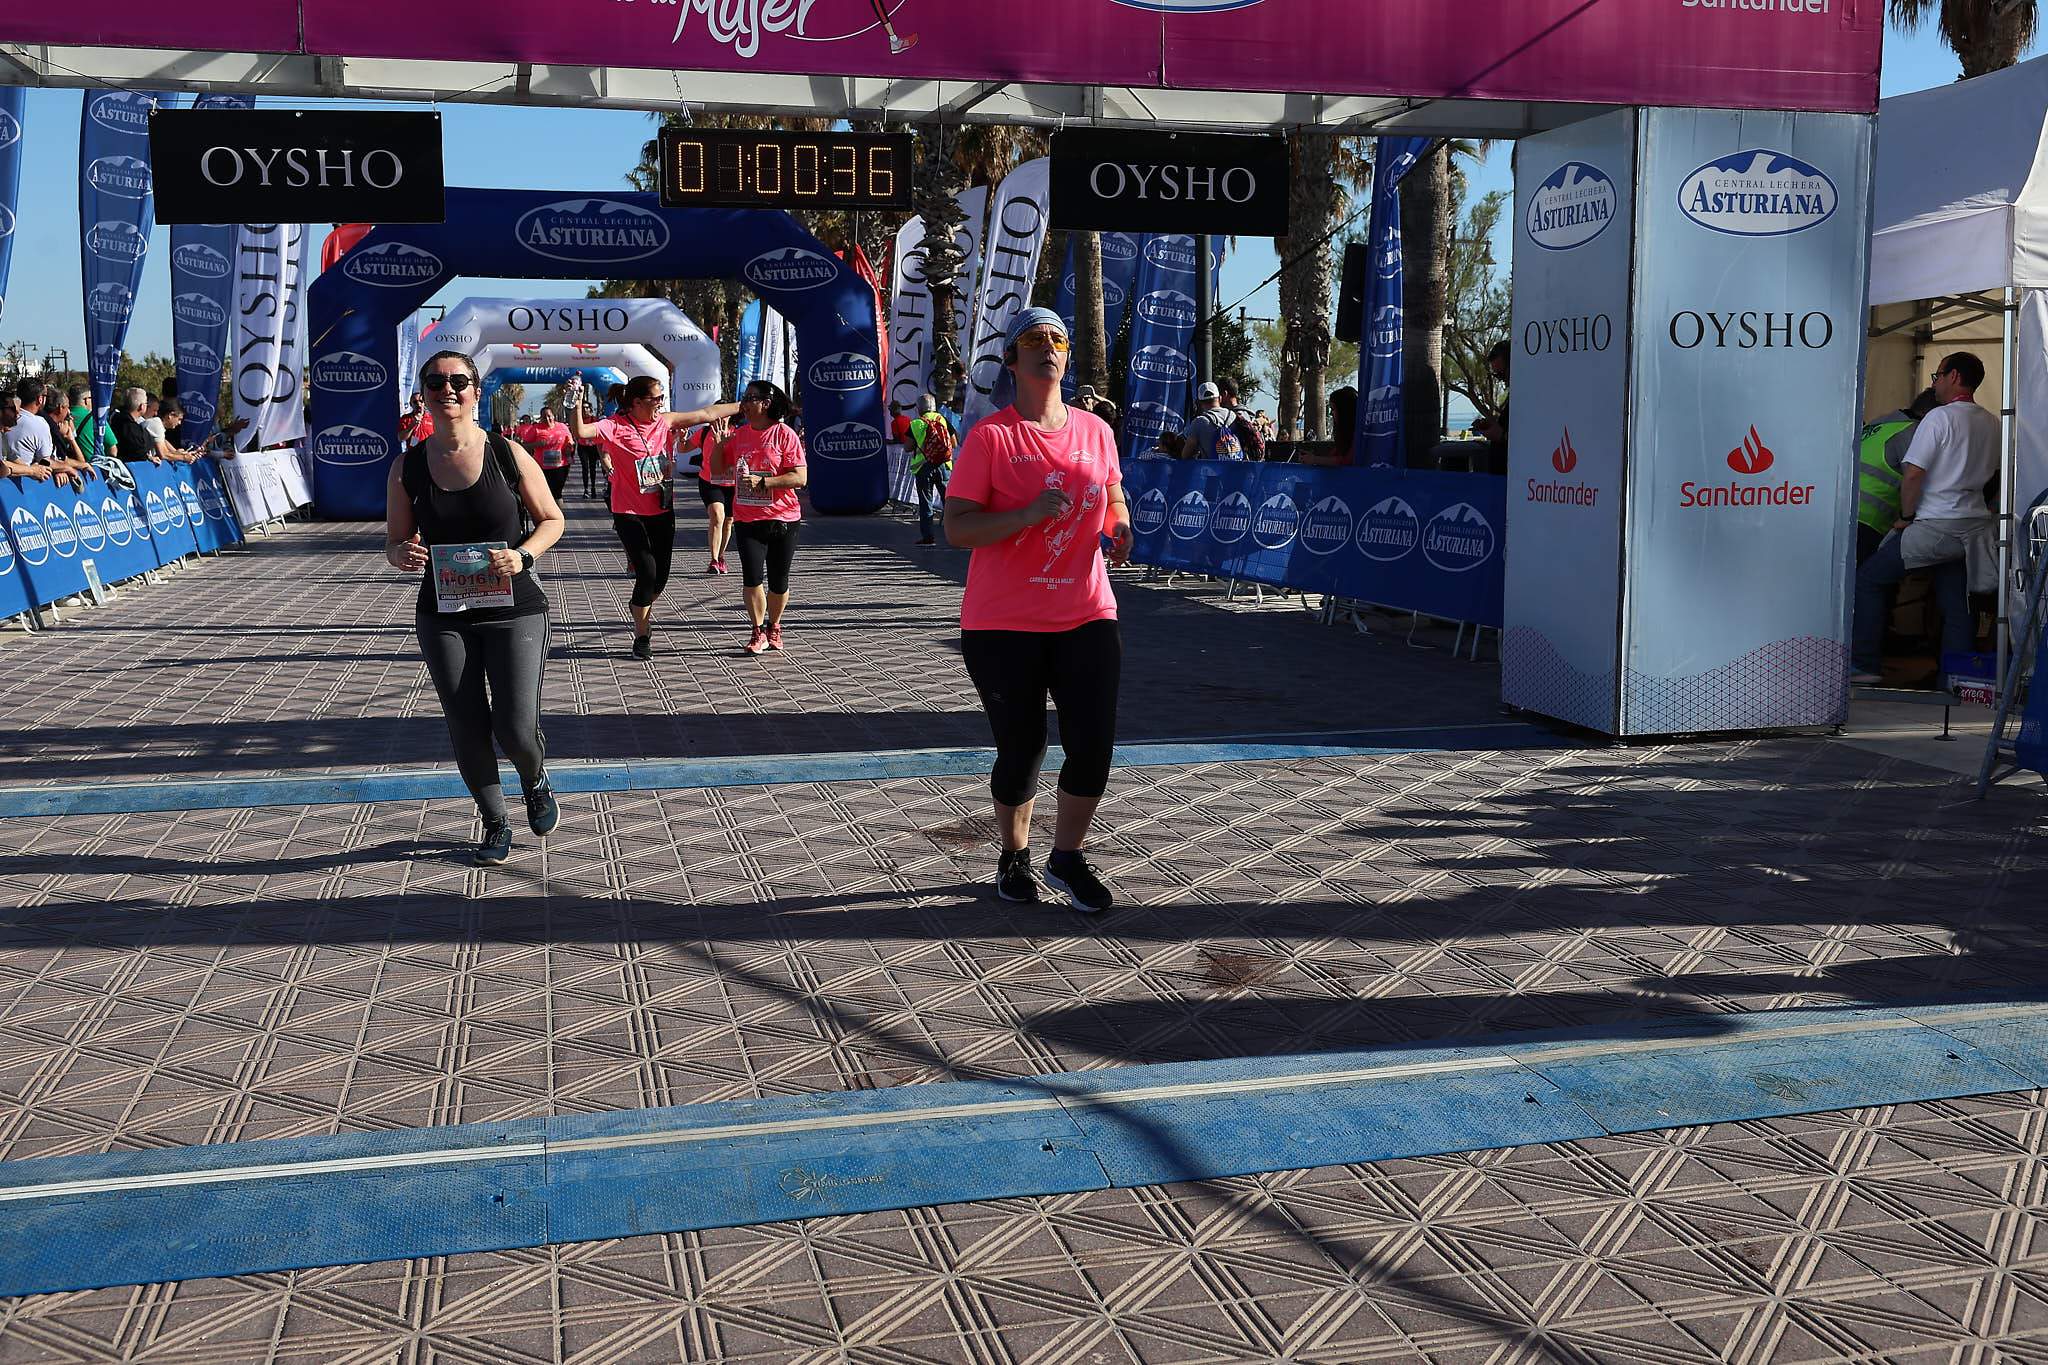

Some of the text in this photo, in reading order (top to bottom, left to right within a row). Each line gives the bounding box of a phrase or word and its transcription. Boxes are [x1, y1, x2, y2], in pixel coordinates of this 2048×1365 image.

[201, 146, 403, 188] OYSHO
[678, 142, 893, 196] 01:00:36
[1090, 162, 1256, 203] OYSHO
[1714, 179, 1821, 189] CENTRAL LECHERA
[1689, 180, 1825, 214] ASTURIANA
[1532, 198, 1609, 233] ASTURIANA
[528, 217, 660, 247] ASTURIANA
[177, 251, 225, 273] ASTURIANA
[349, 258, 435, 276] ASTURIANA
[753, 264, 832, 280] ASTURIANA
[175, 300, 222, 322] ASTURIANA
[508, 307, 629, 331] OYSHO
[435, 334, 472, 343] OYSHO
[663, 334, 699, 342] OYSHO
[1525, 314, 1612, 356] OYSHO
[1669, 311, 1833, 349] OYSHO
[315, 368, 382, 383] ASTURIANA
[682, 382, 716, 391] OYSHO
[813, 368, 875, 382] ASTURIANA
[317, 440, 383, 455] ASTURIANA
[818, 437, 880, 452] ASTURIANA
[1527, 478, 1599, 507] Santander
[1680, 480, 1815, 507] Santander
[1255, 510, 1294, 536] ASTURIANA
[1303, 516, 1347, 541] ASTURIANA
[1359, 519, 1413, 546] ASTURIANA
[1426, 525, 1485, 557] ASTURIANA
